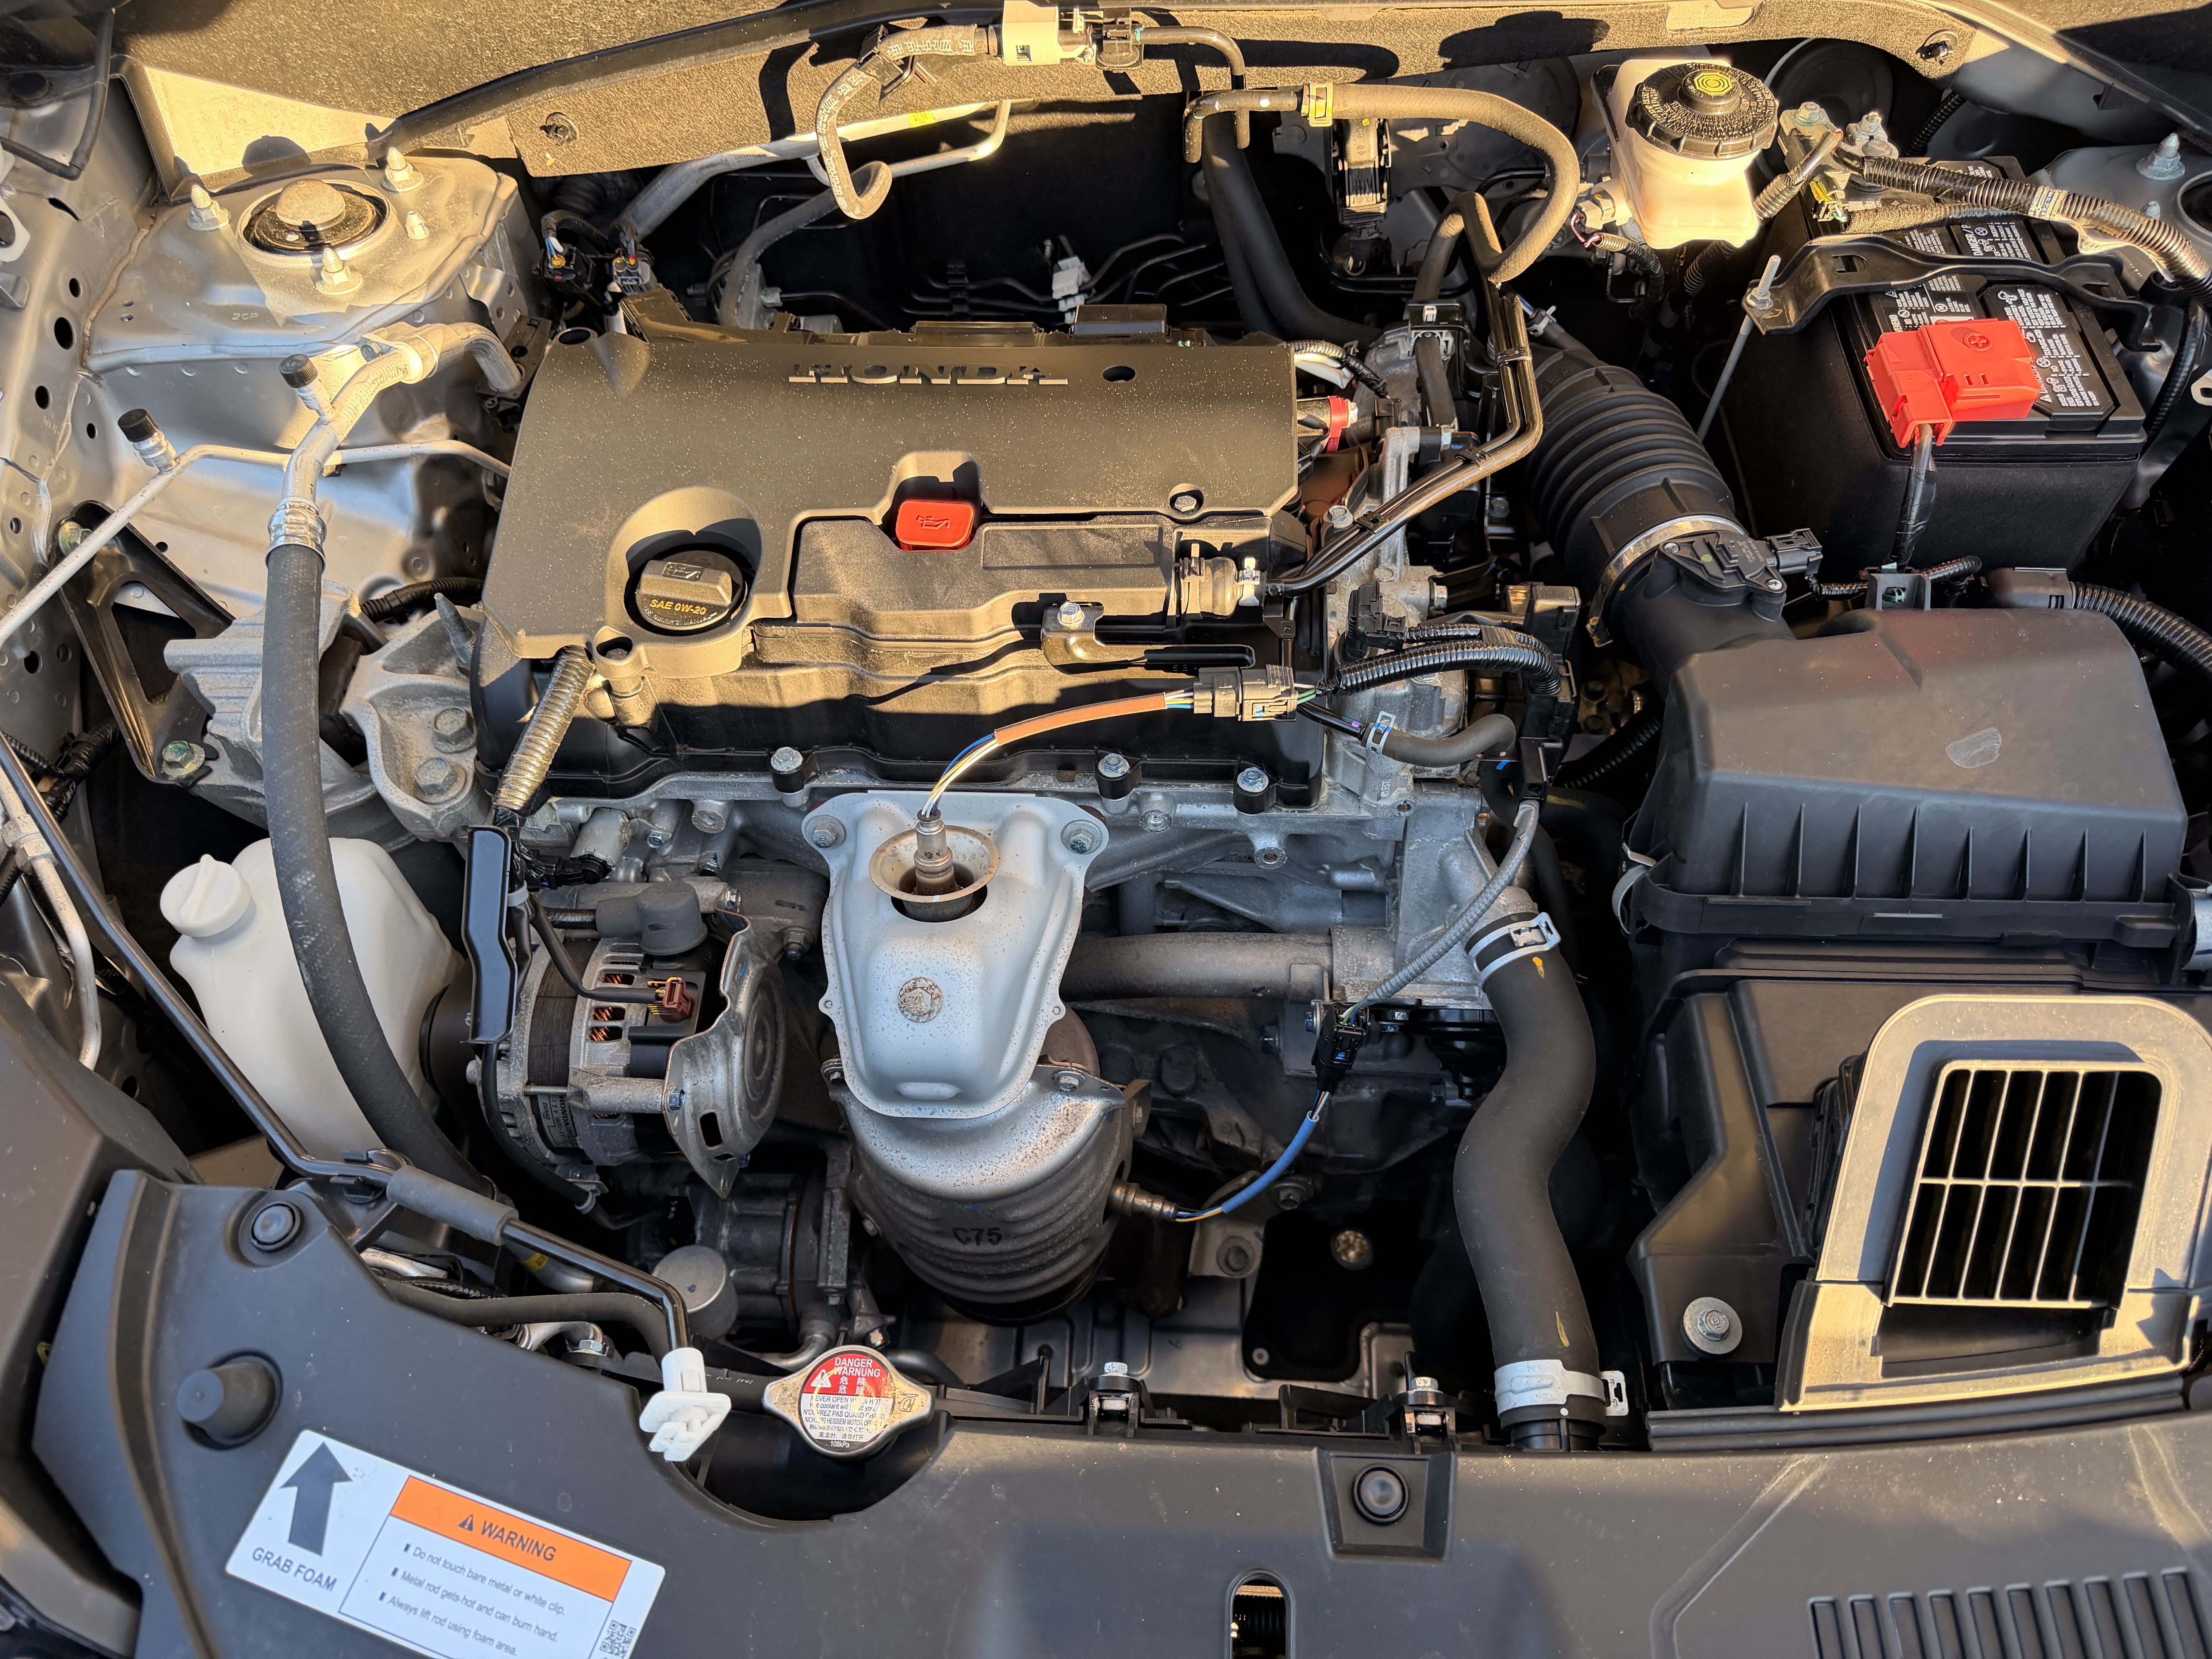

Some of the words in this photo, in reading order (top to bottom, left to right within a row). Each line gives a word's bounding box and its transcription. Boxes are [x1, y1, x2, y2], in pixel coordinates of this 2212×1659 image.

[1961, 224, 1983, 255] DANGER/P
[789, 363, 1068, 385] HONDA
[650, 599, 673, 610] SAE
[674, 603, 708, 615] 0W-20
[559, 1096, 570, 1127] HONDA
[952, 1227, 1002, 1246] C75
[835, 1357, 872, 1368] DANGER
[835, 1366, 881, 1377] WARNUNG
[481, 1520, 557, 1562] WARNING
[252, 1547, 293, 1575] GRAB
[294, 1565, 338, 1592] FOAM
[413, 1546, 425, 1559] Do
[427, 1553, 441, 1566] not
[441, 1558, 466, 1576] touch
[467, 1568, 486, 1584] bare
[488, 1576, 512, 1594] metal
[514, 1587, 522, 1598] or
[524, 1589, 548, 1607] white
[548, 1599, 565, 1616] clip.
[401, 1570, 424, 1587] Metal
[426, 1580, 440, 1594] rod
[441, 1586, 460, 1602] gets
[462, 1593, 476, 1609] hot
[476, 1600, 493, 1615] and
[495, 1607, 511, 1621] can
[513, 1611, 536, 1629] burn
[538, 1622, 558, 1642] hand.
[388, 1596, 419, 1616] Always
[421, 1608, 431, 1620] lift
[432, 1612, 447, 1626] rod
[447, 1619, 471, 1639] using
[472, 1629, 495, 1646] foam
[496, 1640, 517, 1656] area.
